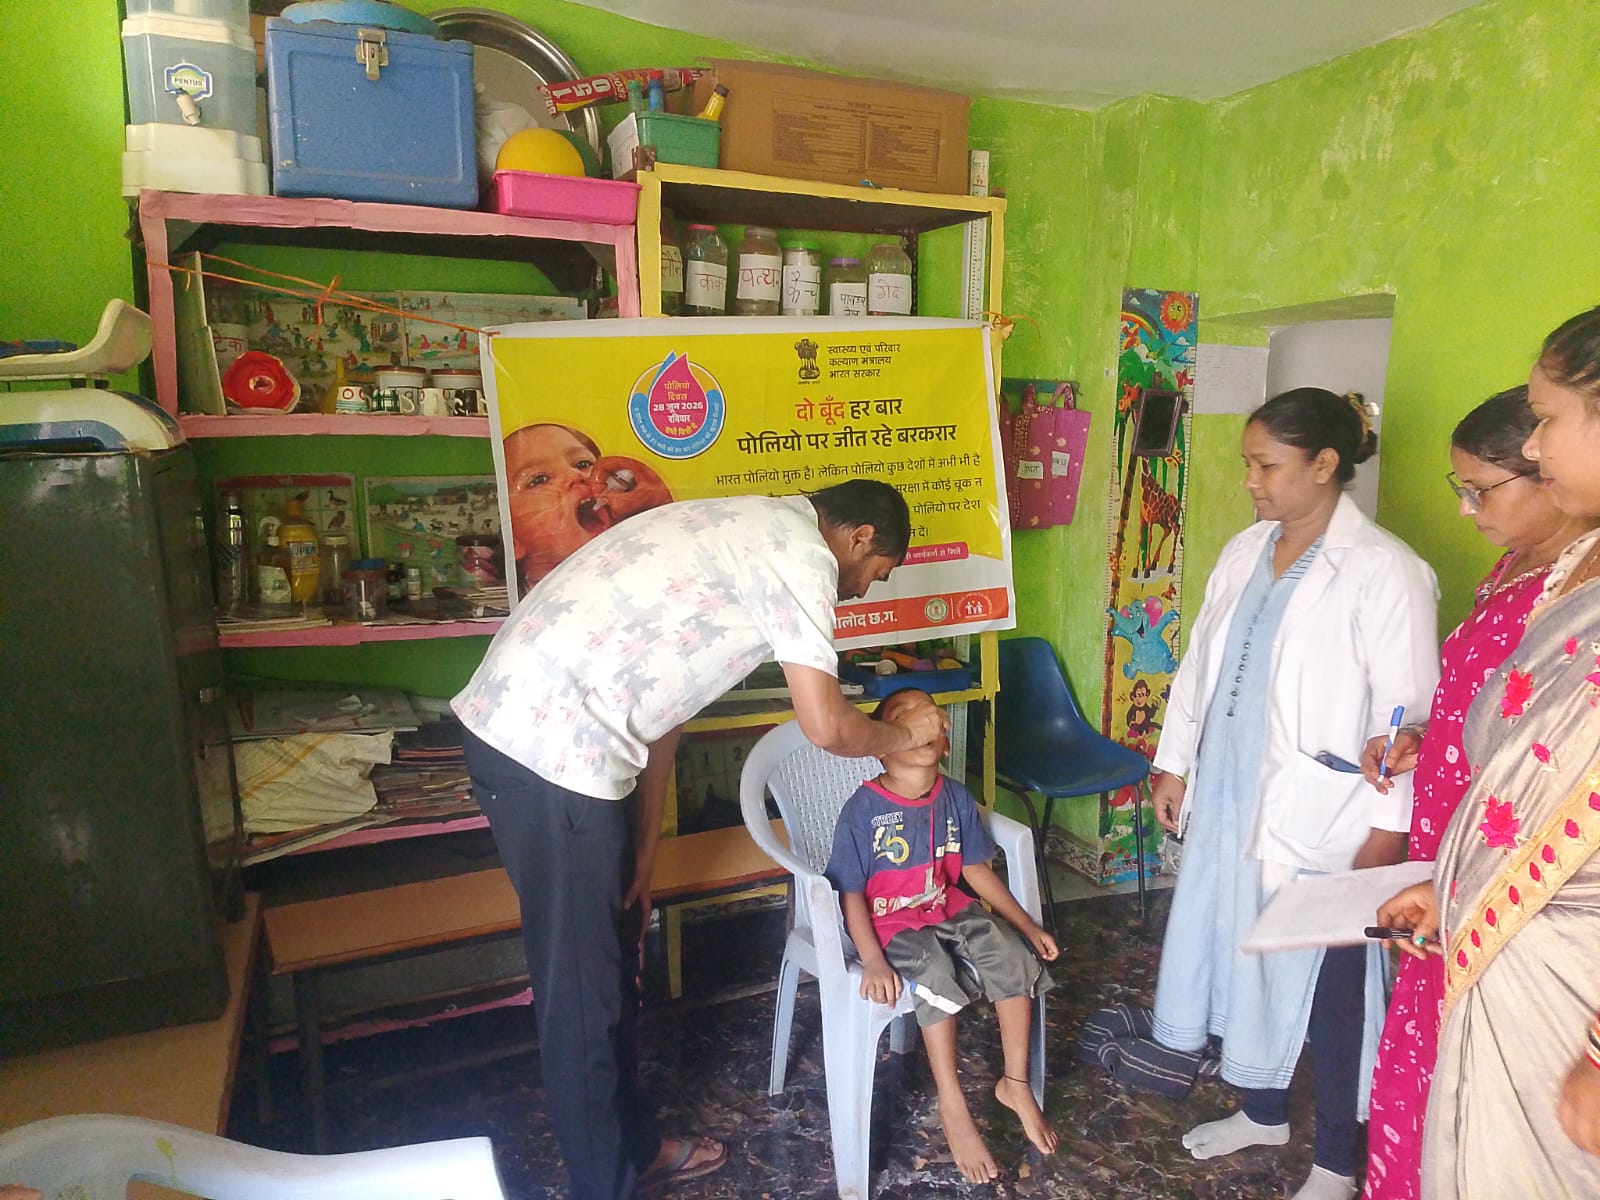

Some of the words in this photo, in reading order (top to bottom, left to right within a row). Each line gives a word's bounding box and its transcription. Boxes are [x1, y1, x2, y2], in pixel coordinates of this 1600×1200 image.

[552, 78, 611, 99] 150
[859, 342, 872, 354] एवं
[874, 342, 901, 353] परिवार
[828, 358, 859, 367] कल्याण
[861, 354, 892, 365] मंत्रालय
[829, 370, 850, 378] भारत
[853, 369, 880, 378] सरकार
[653, 404, 665, 412] 28
[666, 403, 680, 413] जून
[681, 402, 704, 410] 2026
[795, 398, 814, 421] दो
[819, 395, 845, 425] बूँद
[849, 400, 871, 420] हर
[875, 398, 903, 415] बार
[668, 413, 691, 423] रविवार
[737, 428, 802, 454] पोलियो
[806, 432, 830, 450] पर
[833, 425, 868, 449] जीत
[871, 424, 894, 447] रहे
[896, 424, 957, 444] बरकरार
[716, 475, 741, 486] भारत
[744, 471, 779, 485] पोलियो
[782, 471, 801, 485] मुक्त
[818, 465, 849, 478] लेकिन
[850, 460, 885, 474] पोलियो
[887, 461, 905, 478] कुछ
[938, 454, 956, 467] अभी
[959, 454, 970, 467] भी
[973, 452, 981, 467] है
[931, 477, 951, 491] कोई
[953, 478, 972, 492] चूक
[973, 477, 982, 487] न
[913, 500, 946, 514] पोलियो
[948, 502, 960, 511] पर
[963, 498, 981, 510] देश
[834, 611, 867, 630] ालोद
[869, 610, 898, 626] छ.ग.
